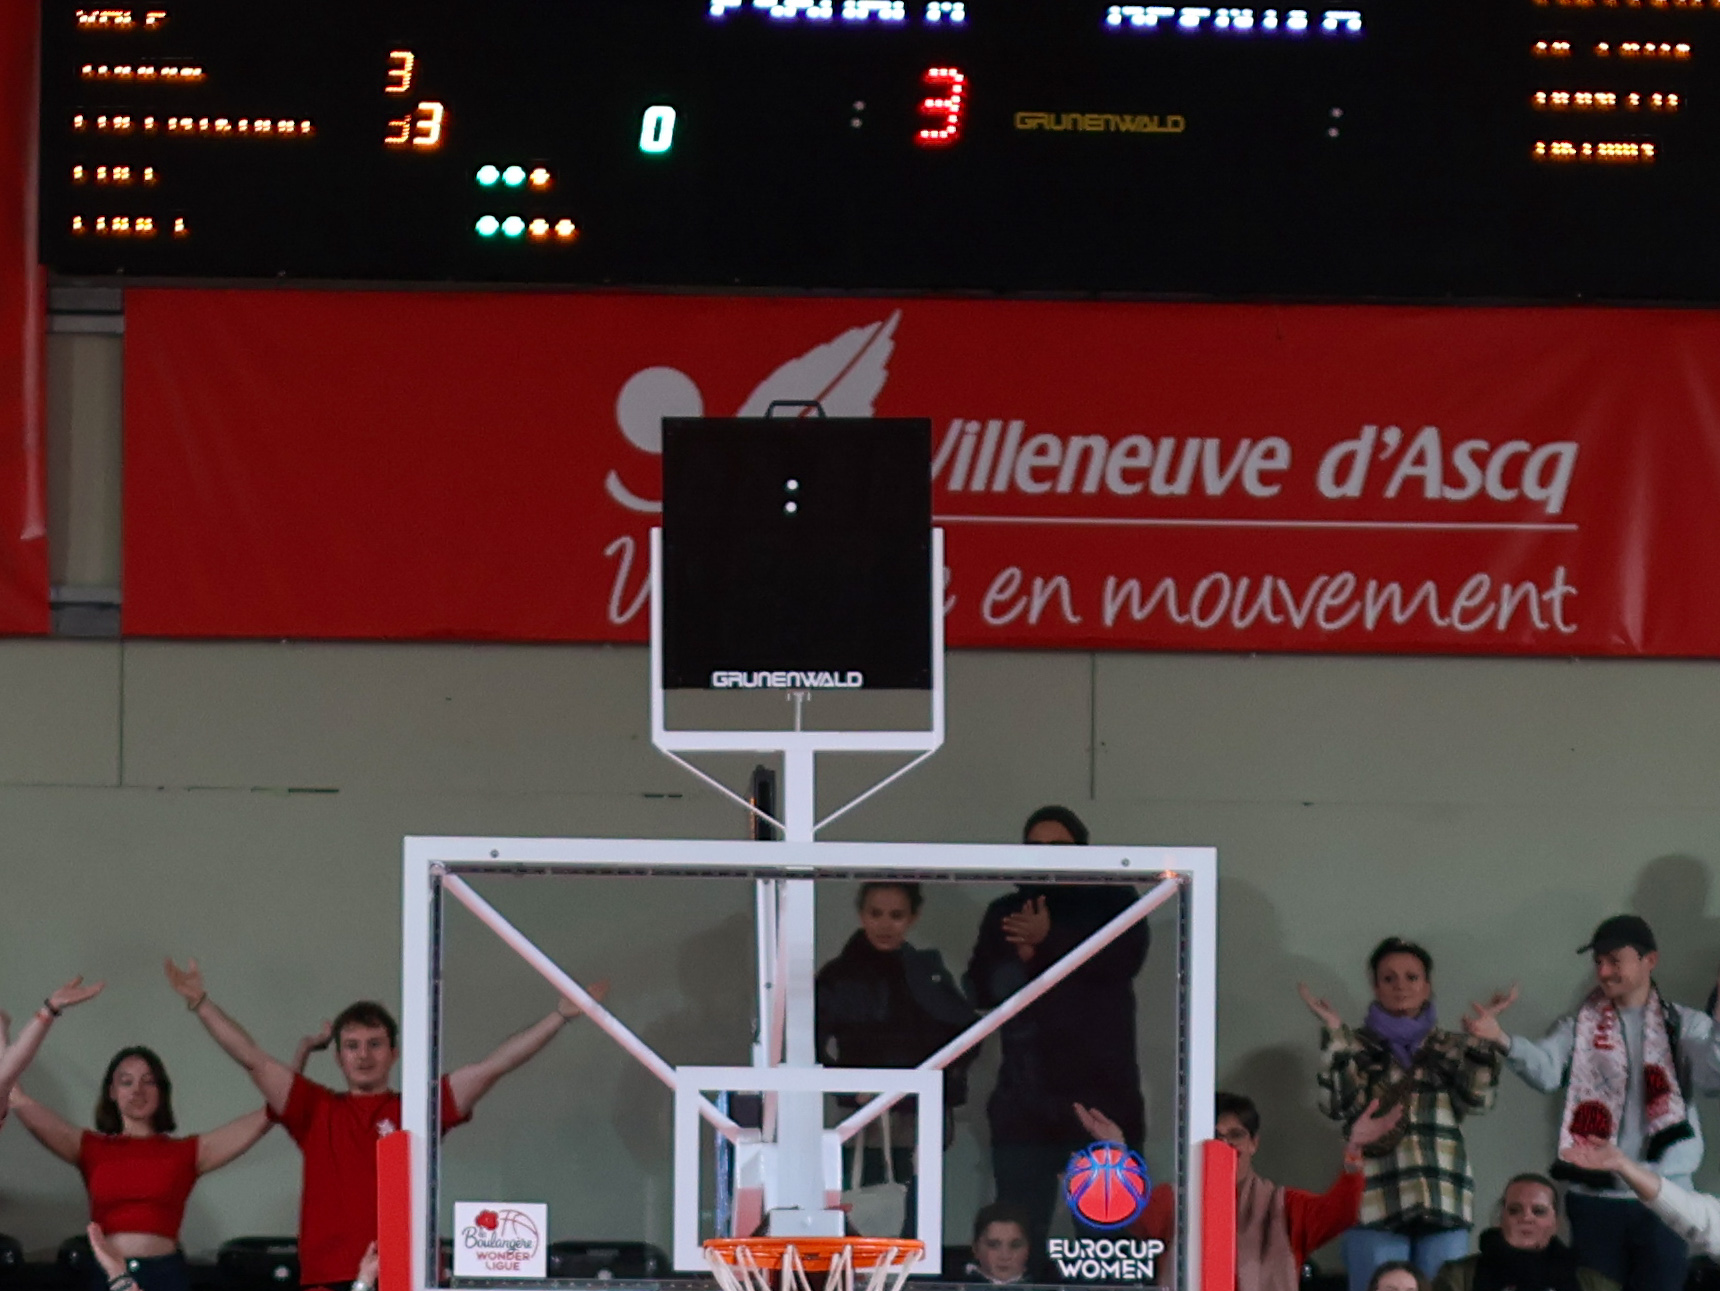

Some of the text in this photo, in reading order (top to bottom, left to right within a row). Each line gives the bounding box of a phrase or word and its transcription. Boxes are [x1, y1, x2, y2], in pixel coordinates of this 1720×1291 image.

[915, 66, 967, 146] 3
[640, 104, 677, 153] 0
[1015, 111, 1185, 134] GRUNENWALD
[1317, 424, 1580, 517] d'Ascq
[982, 566, 1082, 627] en
[1103, 566, 1578, 635] mouvement
[711, 671, 863, 689] GRUNENWALD
[476, 1251, 531, 1261] WONDER
[1048, 1238, 1165, 1259] EUROCUP
[485, 1261, 521, 1271] LIGUE
[1058, 1259, 1155, 1280] WOMEN
